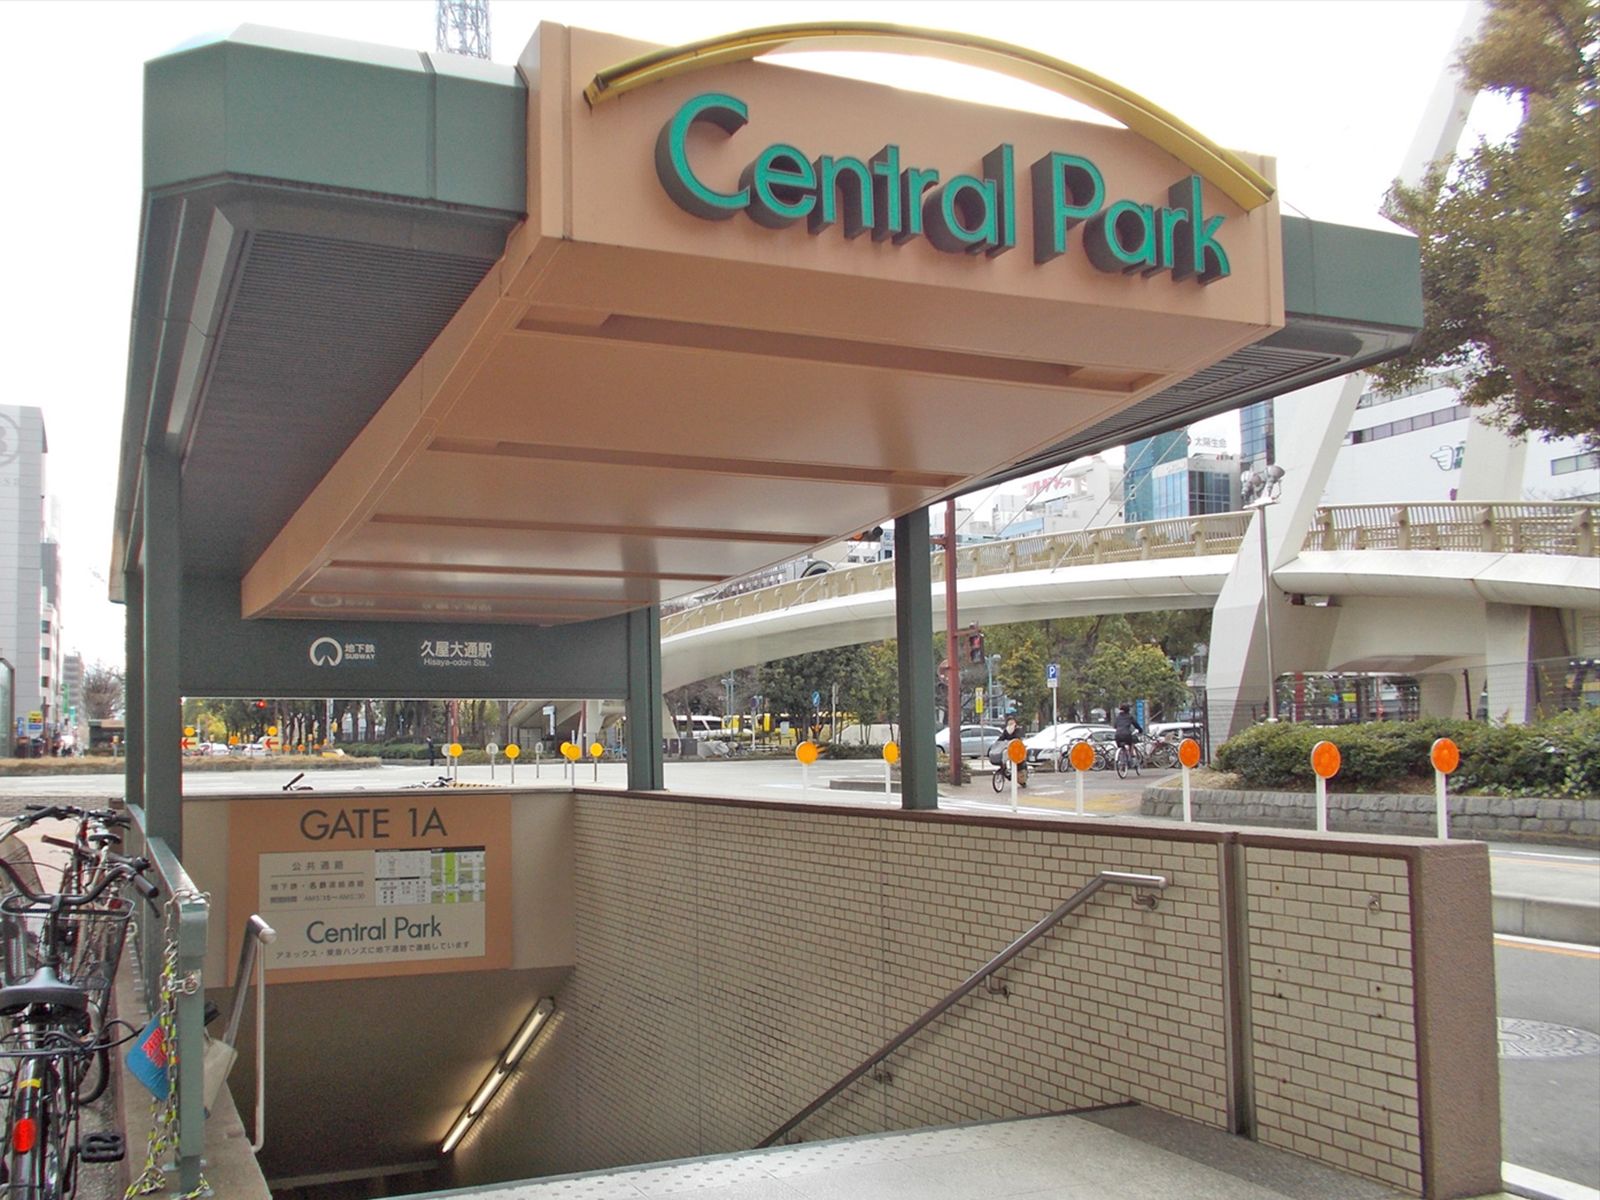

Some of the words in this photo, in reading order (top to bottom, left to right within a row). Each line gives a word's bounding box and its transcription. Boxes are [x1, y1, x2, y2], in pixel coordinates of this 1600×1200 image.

[658, 92, 1016, 256] Central
[1032, 151, 1231, 285] Park
[344, 643, 376, 654] 地下鉄
[420, 640, 492, 659] 久屋大通駅
[1049, 666, 1056, 678] P
[300, 808, 390, 841] GATE
[408, 807, 448, 838] 1A
[291, 860, 344, 871] 公共通路
[306, 917, 386, 944] Central
[394, 915, 442, 939] Park
